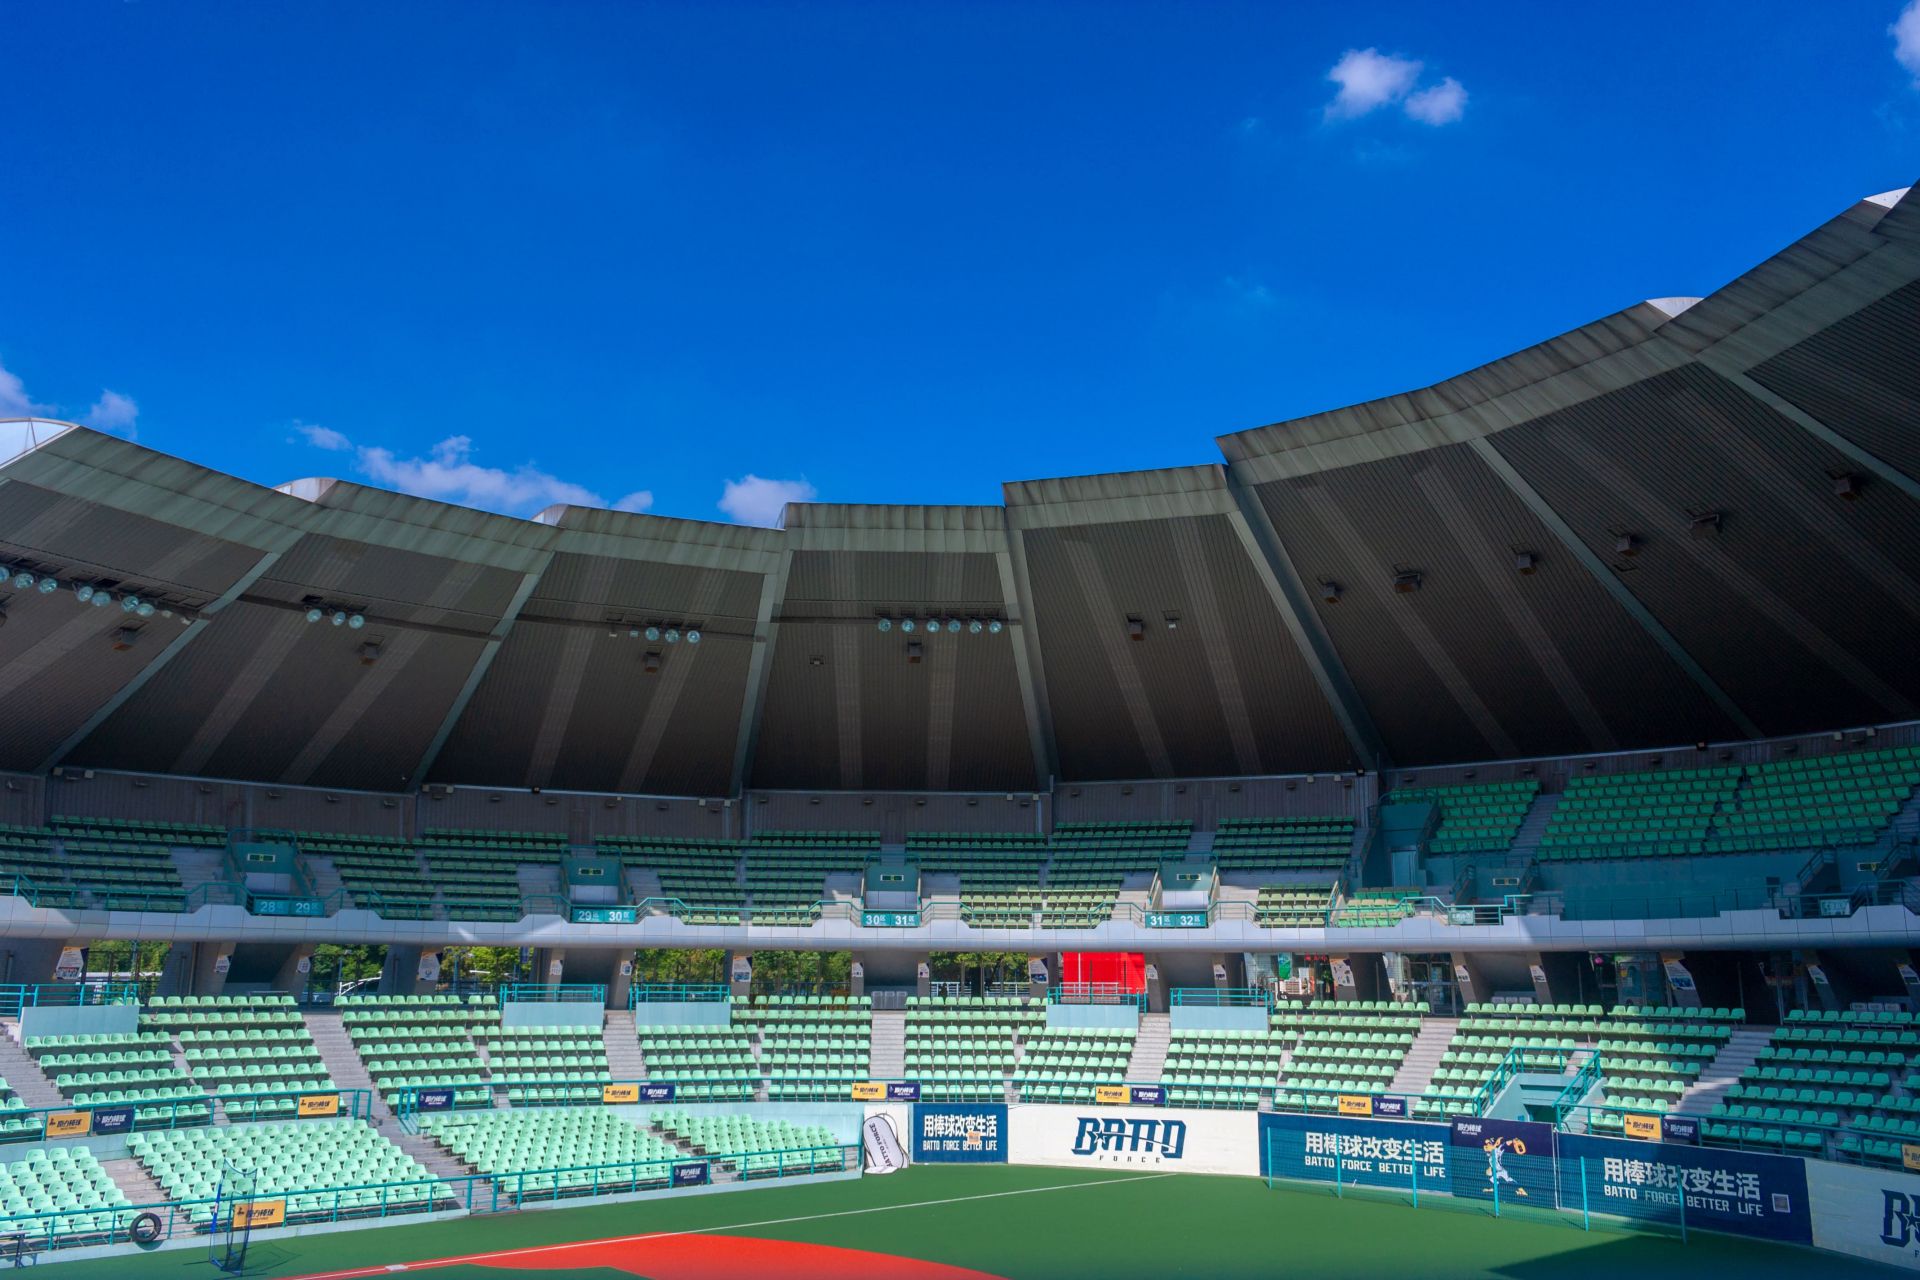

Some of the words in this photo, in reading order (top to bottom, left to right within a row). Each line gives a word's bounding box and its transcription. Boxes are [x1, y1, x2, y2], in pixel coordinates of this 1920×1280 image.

[924, 1114, 997, 1138] 用棒球改变生活
[1071, 1117, 1186, 1159] BATTO
[923, 1140, 940, 1151] BATTO
[943, 1140, 959, 1151] FORCE
[986, 1140, 997, 1151] LIFE
[1305, 1131, 1445, 1164] 用棒球改变生活
[1305, 1155, 1335, 1168] BATTO
[1342, 1159, 1372, 1172] FORCE
[1423, 1166, 1446, 1178] LIFE
[1603, 1157, 1761, 1201] 用棒球改变生活
[1604, 1185, 1637, 1200] BATTO
[1645, 1190, 1680, 1206] FORCE
[1686, 1195, 1729, 1212] BETTER
[1738, 1202, 1764, 1217] LIFE
